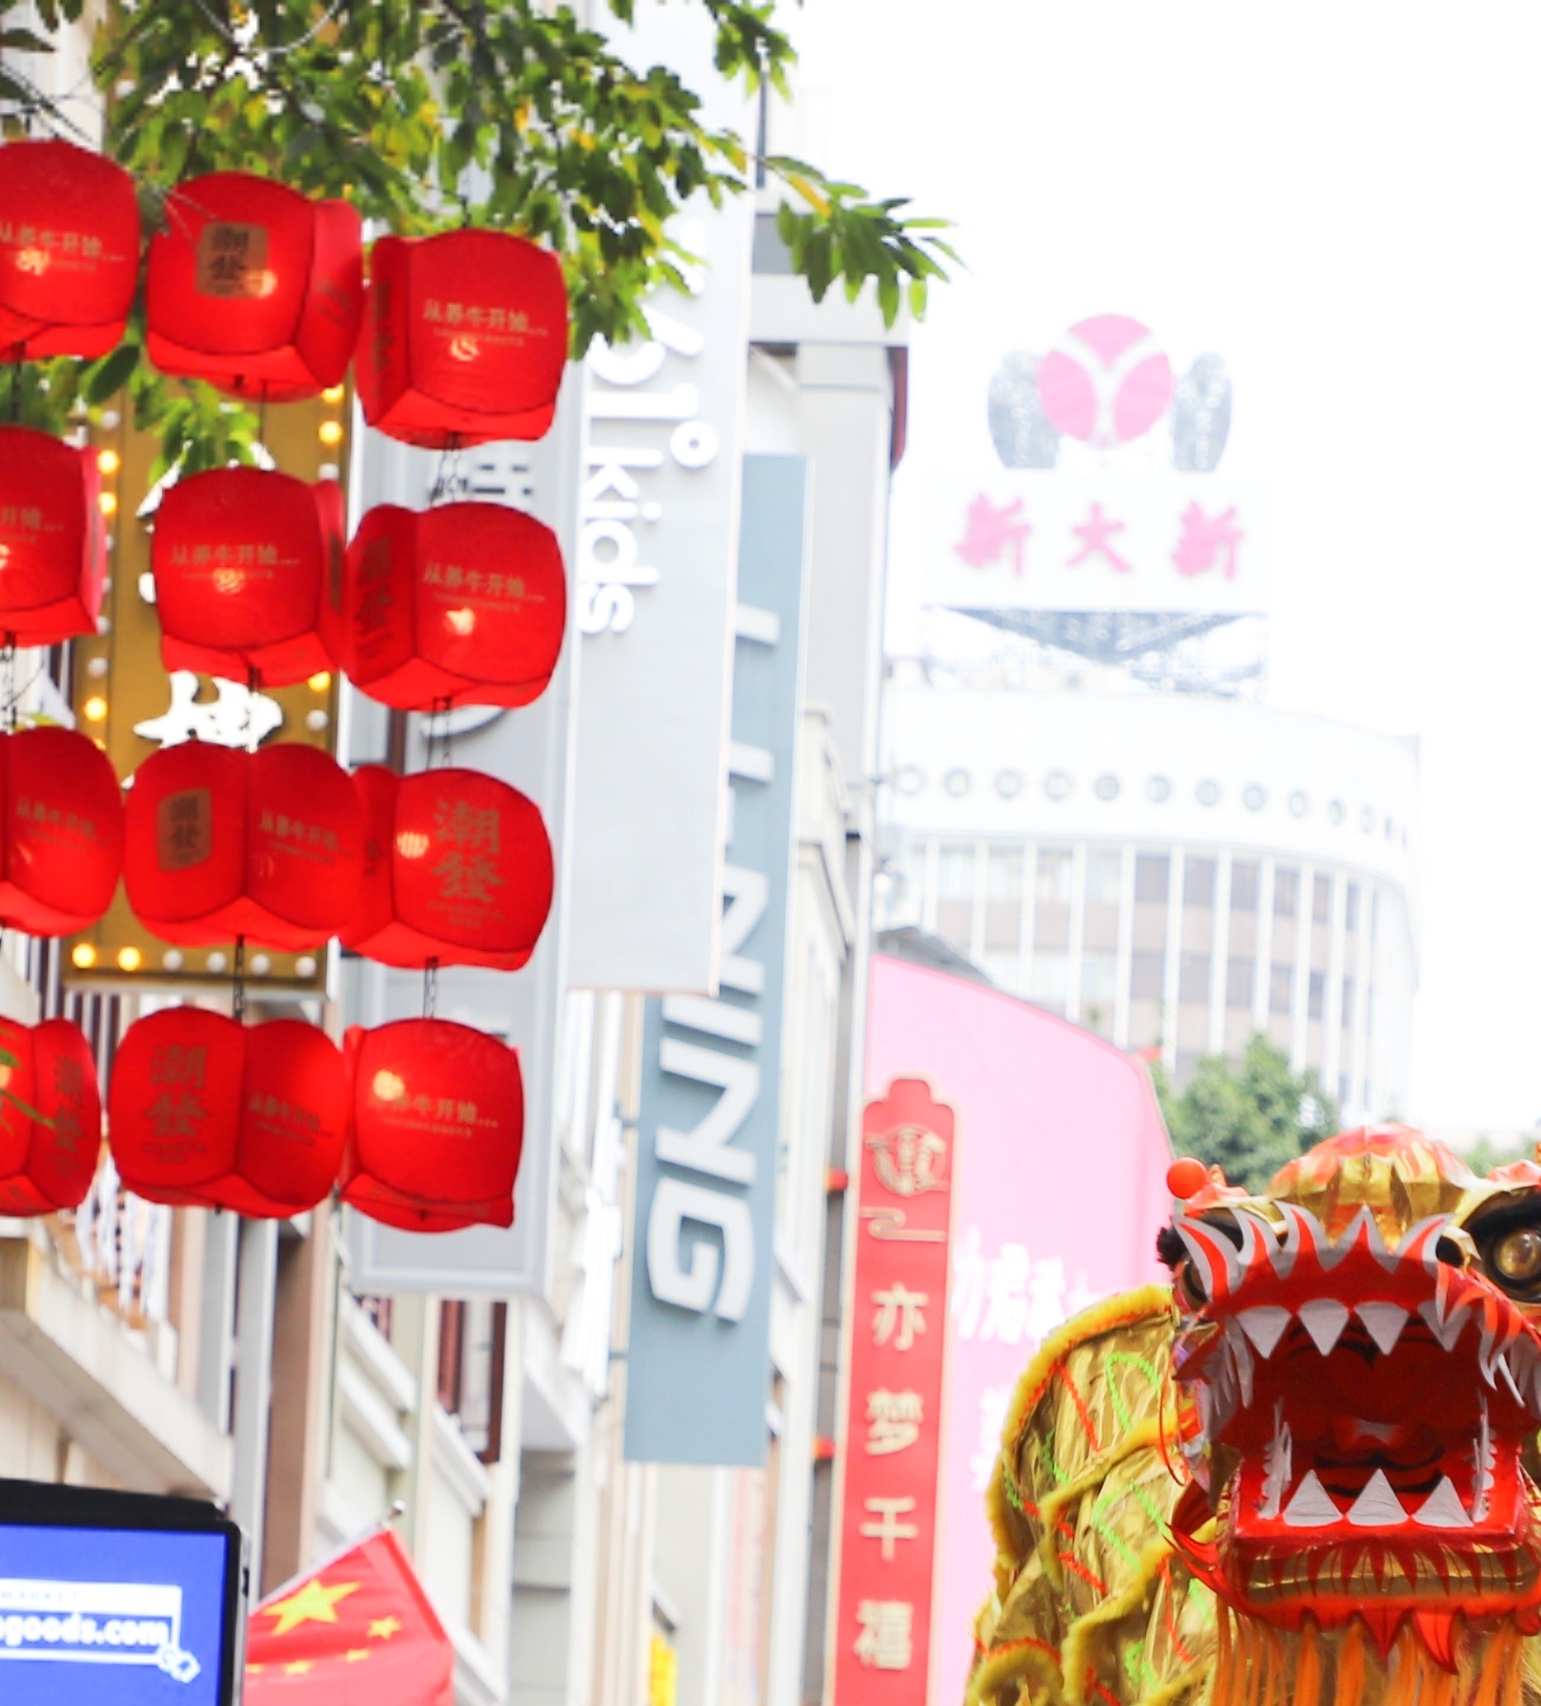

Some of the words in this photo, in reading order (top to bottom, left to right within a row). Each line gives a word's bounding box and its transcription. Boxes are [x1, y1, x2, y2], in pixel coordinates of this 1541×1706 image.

[577, 445, 663, 636] kids
[953, 490, 1246, 582] 新大新
